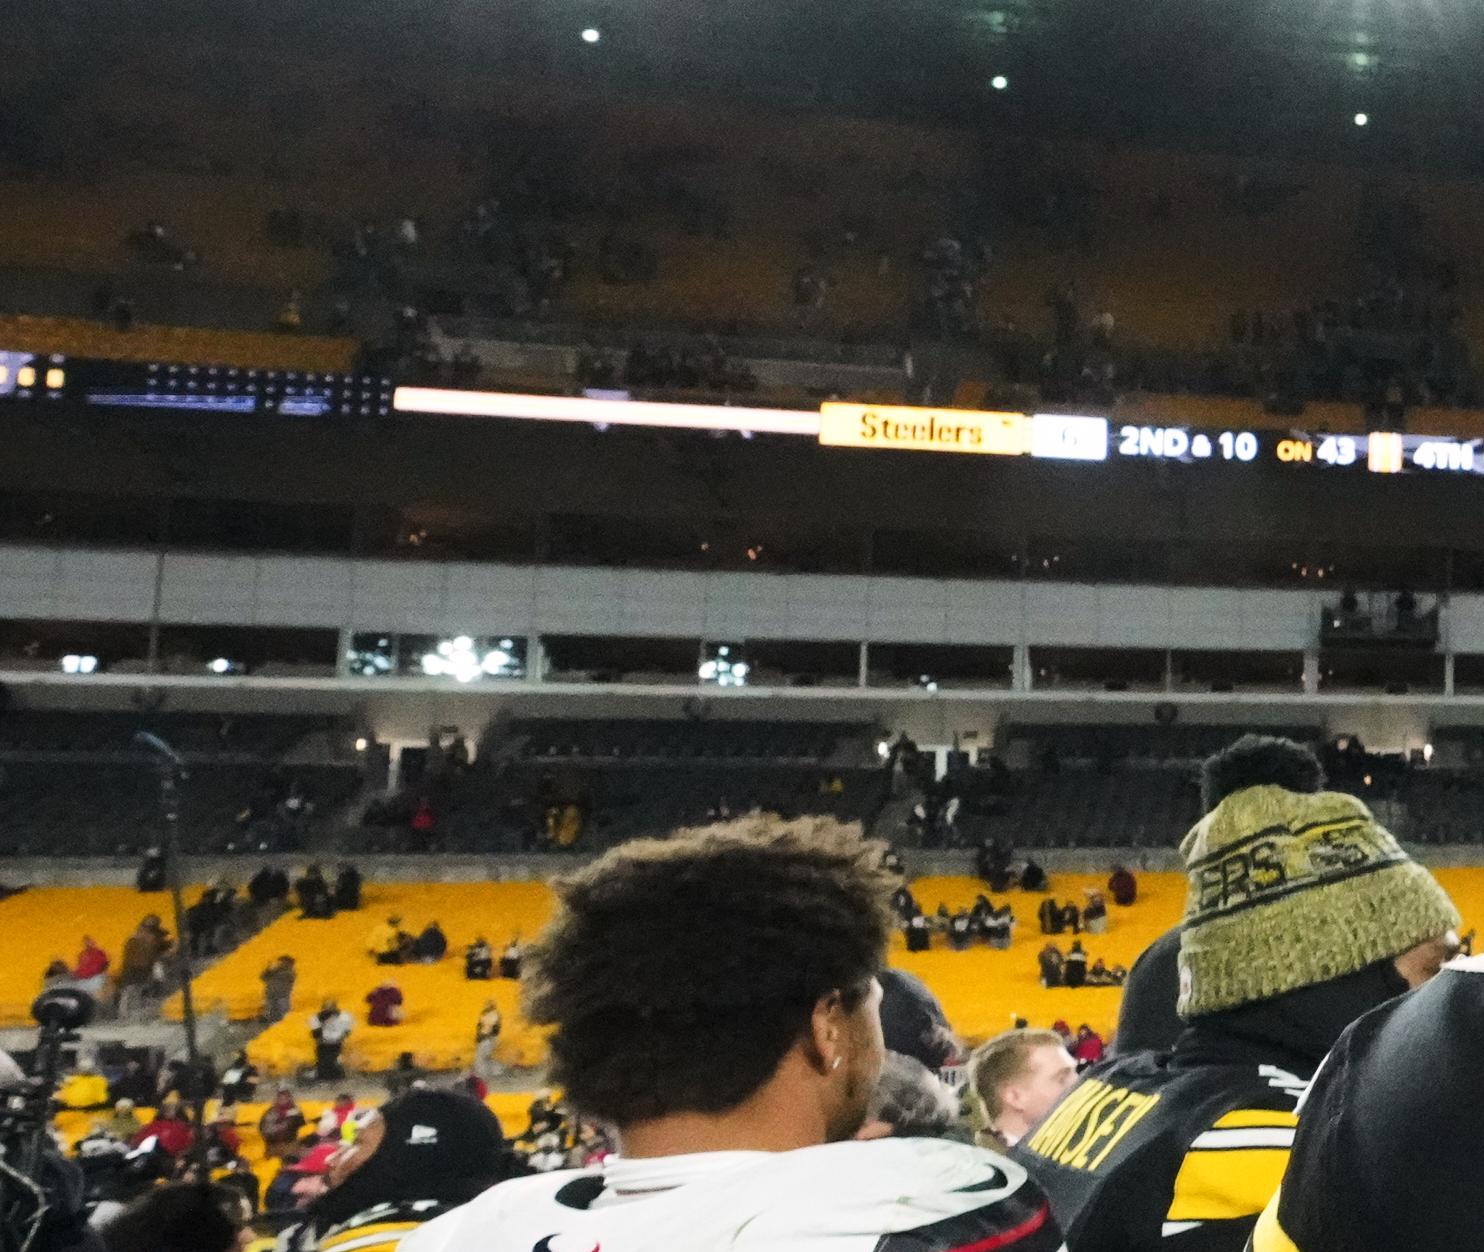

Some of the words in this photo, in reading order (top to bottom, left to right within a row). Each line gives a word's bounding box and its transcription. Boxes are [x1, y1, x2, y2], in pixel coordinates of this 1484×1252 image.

[860, 411, 983, 445] Steelers
[1119, 426, 1189, 456] 2ND
[1219, 432, 1258, 461] 10
[1277, 440, 1312, 462] ON
[1317, 437, 1356, 465] 43
[1413, 441, 1474, 471] 4TH
